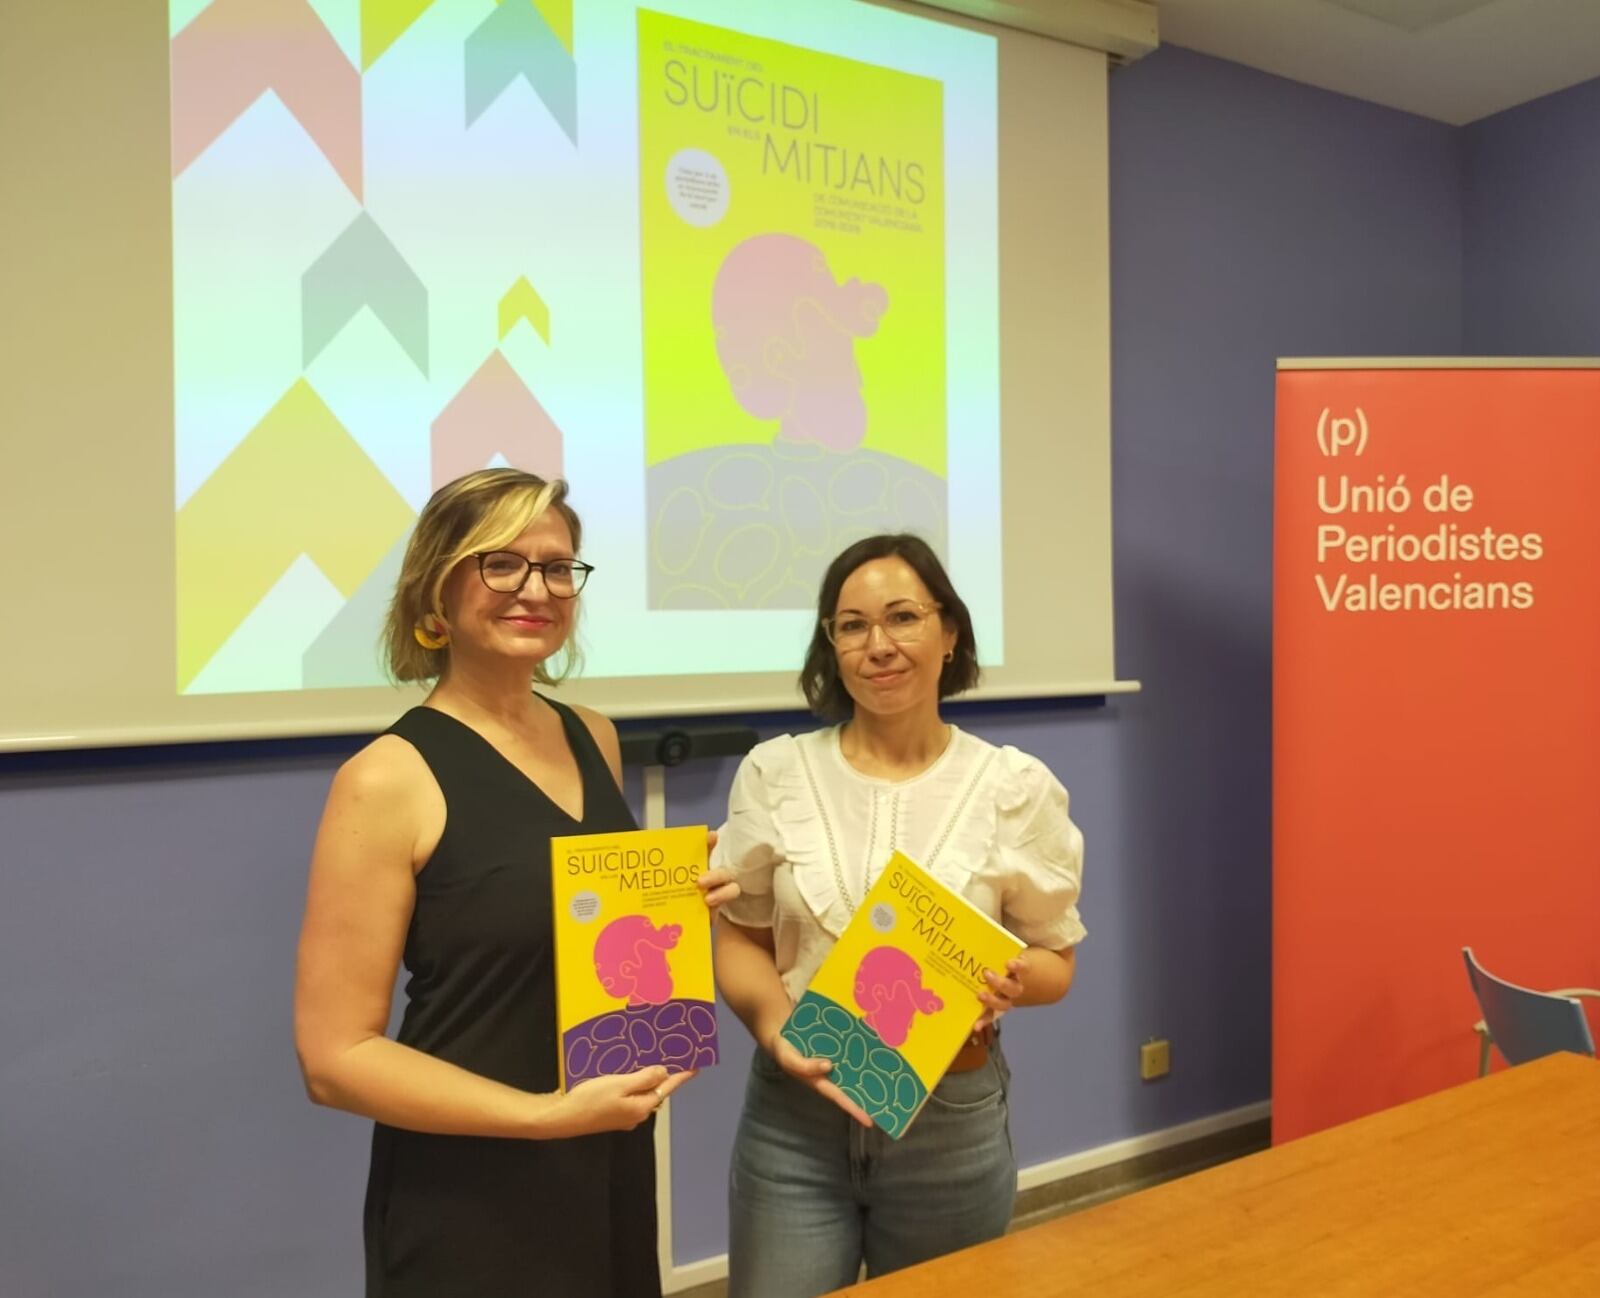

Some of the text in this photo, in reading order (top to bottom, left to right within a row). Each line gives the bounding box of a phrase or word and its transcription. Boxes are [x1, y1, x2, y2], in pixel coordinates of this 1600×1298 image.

[762, 132, 926, 205] MITJANS
[1316, 406, 1369, 457] (p)
[1317, 473, 1474, 514] Unió de
[1317, 523, 1544, 563] Periodistes
[1314, 572, 1535, 612] Valencians
[567, 847, 665, 876] SUICIDIO
[619, 864, 700, 892] MEDIOS
